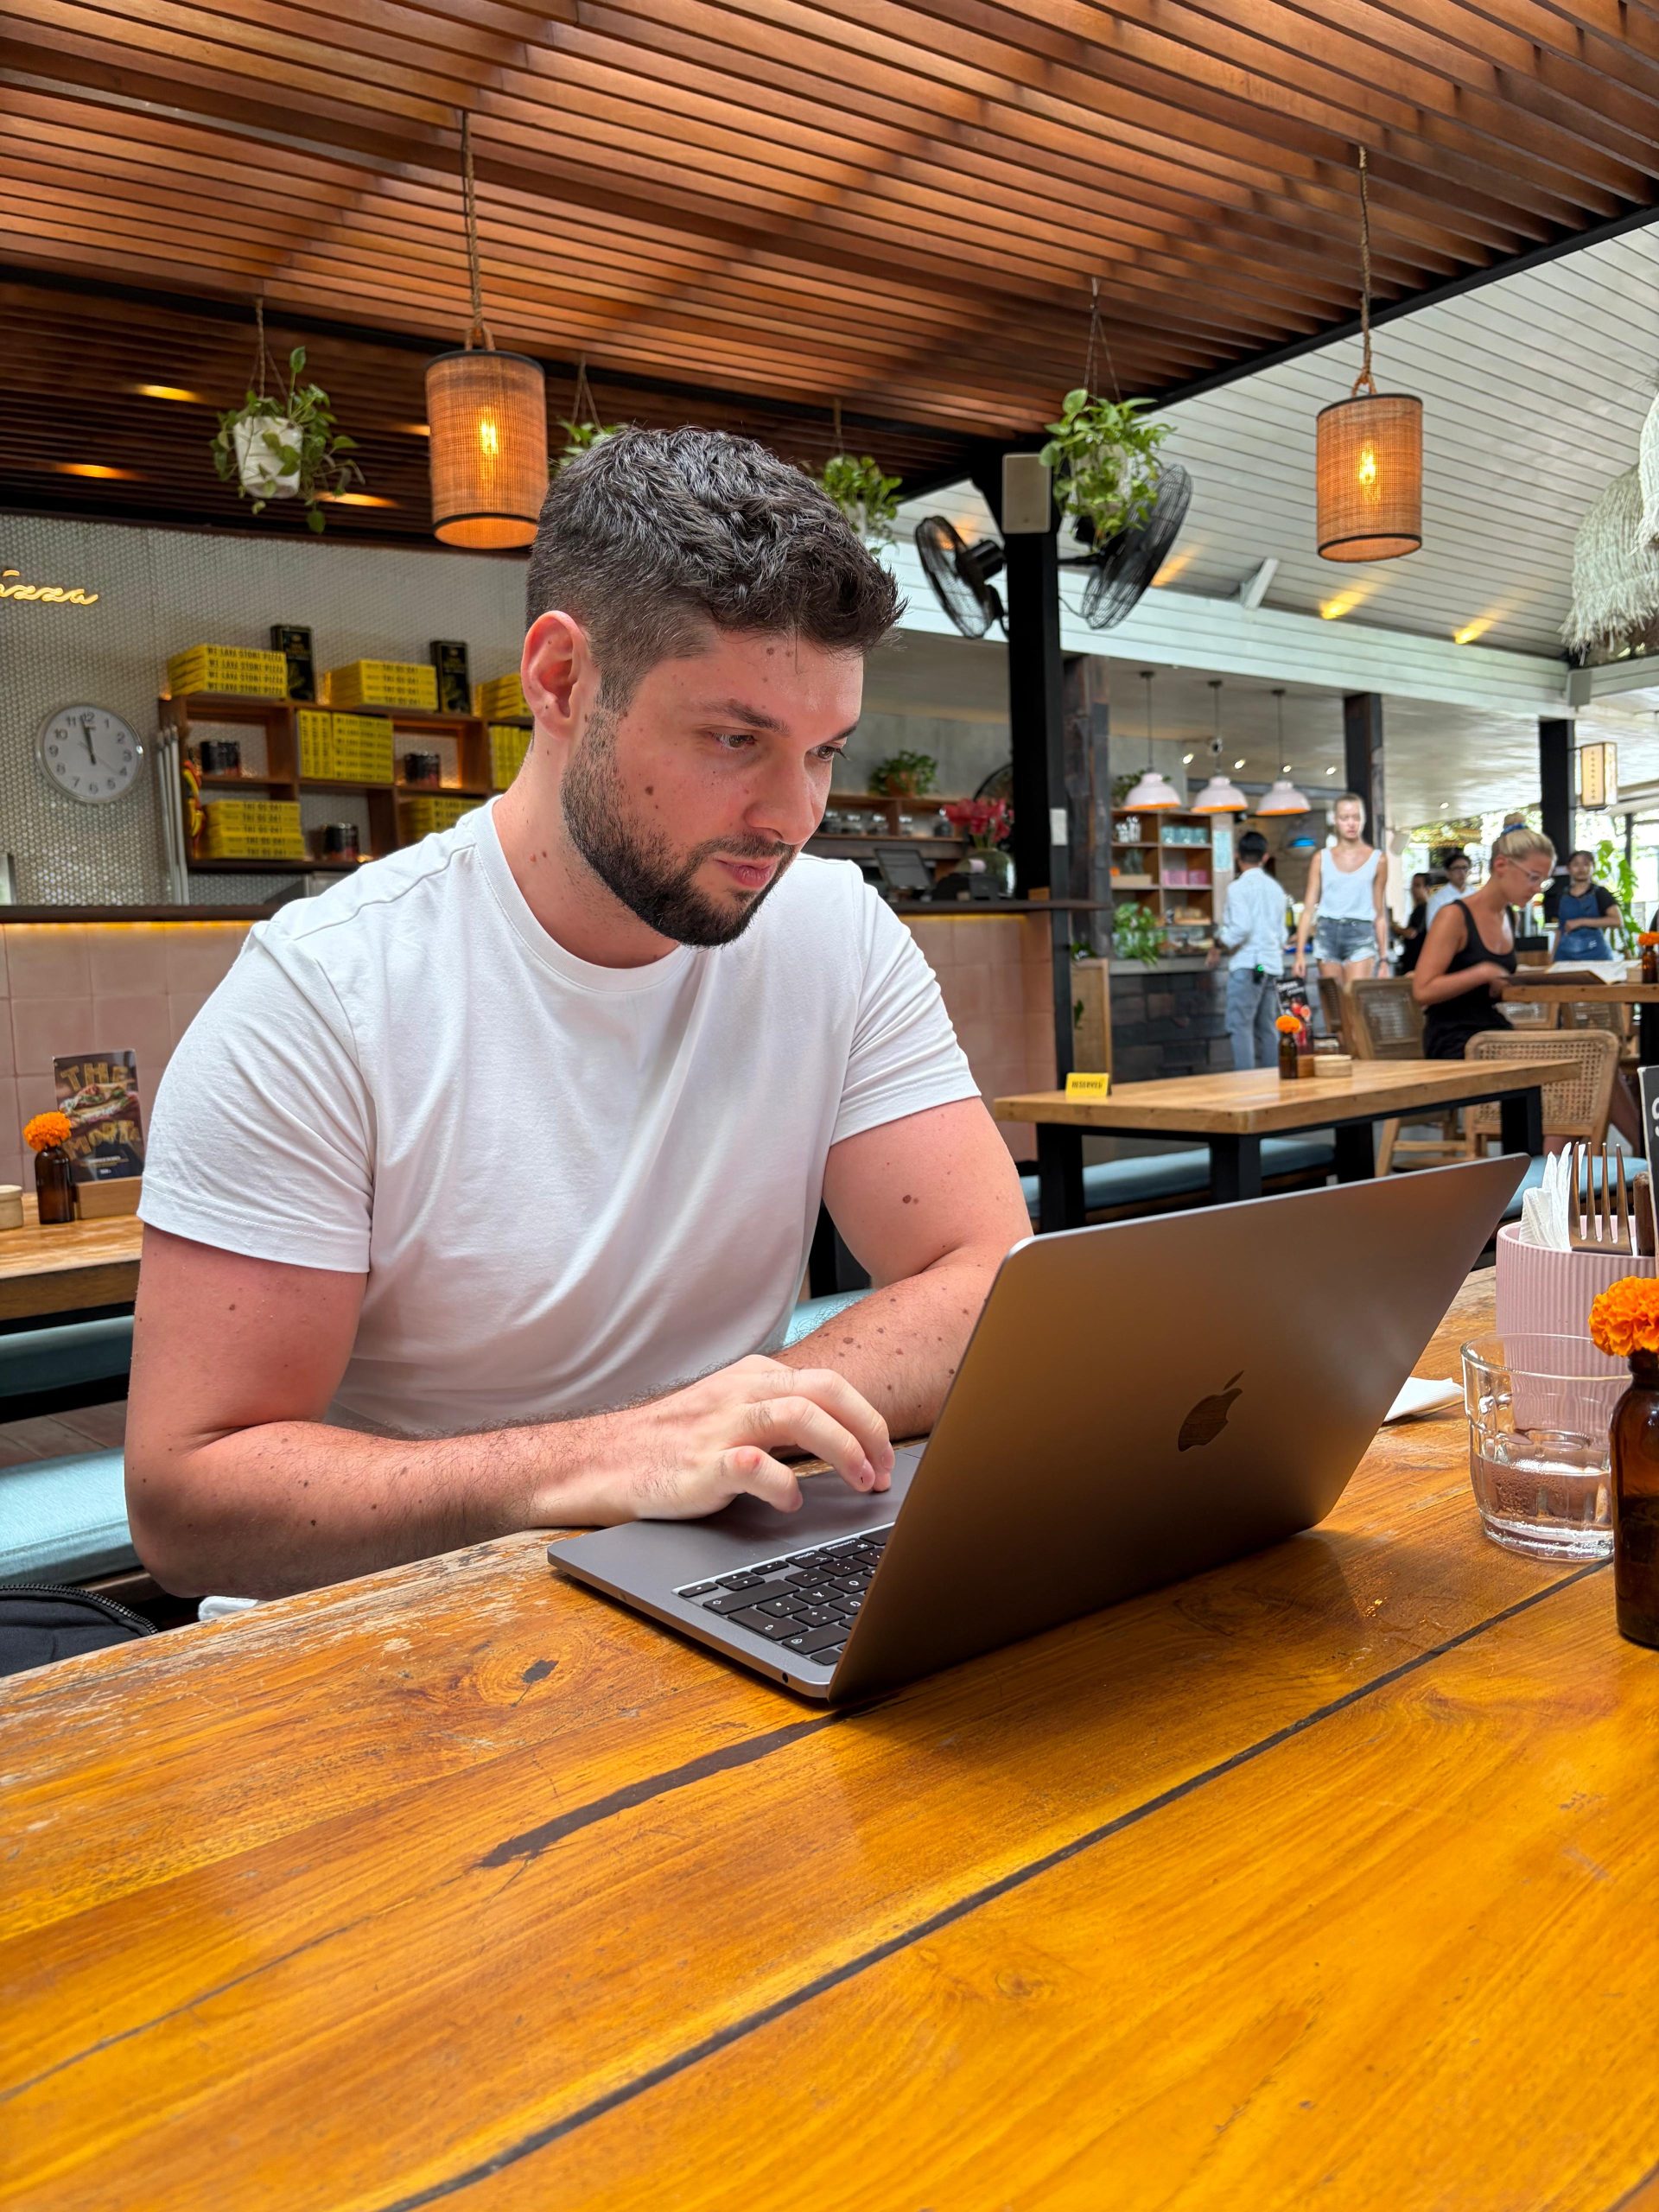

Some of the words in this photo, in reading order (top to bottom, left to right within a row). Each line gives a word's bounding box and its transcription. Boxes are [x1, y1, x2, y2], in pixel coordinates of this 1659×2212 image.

[67, 715, 77, 727] 11
[83, 711, 95, 722] 12
[105, 718, 110, 728] 1
[54, 728, 68, 741] 10
[117, 731, 125, 744] 2
[49, 745, 59, 758] 9
[123, 749, 132, 762] 3
[56, 762, 66, 776] 8
[119, 766, 127, 777] 4
[72, 777, 80, 788] 7
[89, 782, 99, 795] 6
[107, 779, 116, 790] 5
[60, 1062, 129, 1092] THE
